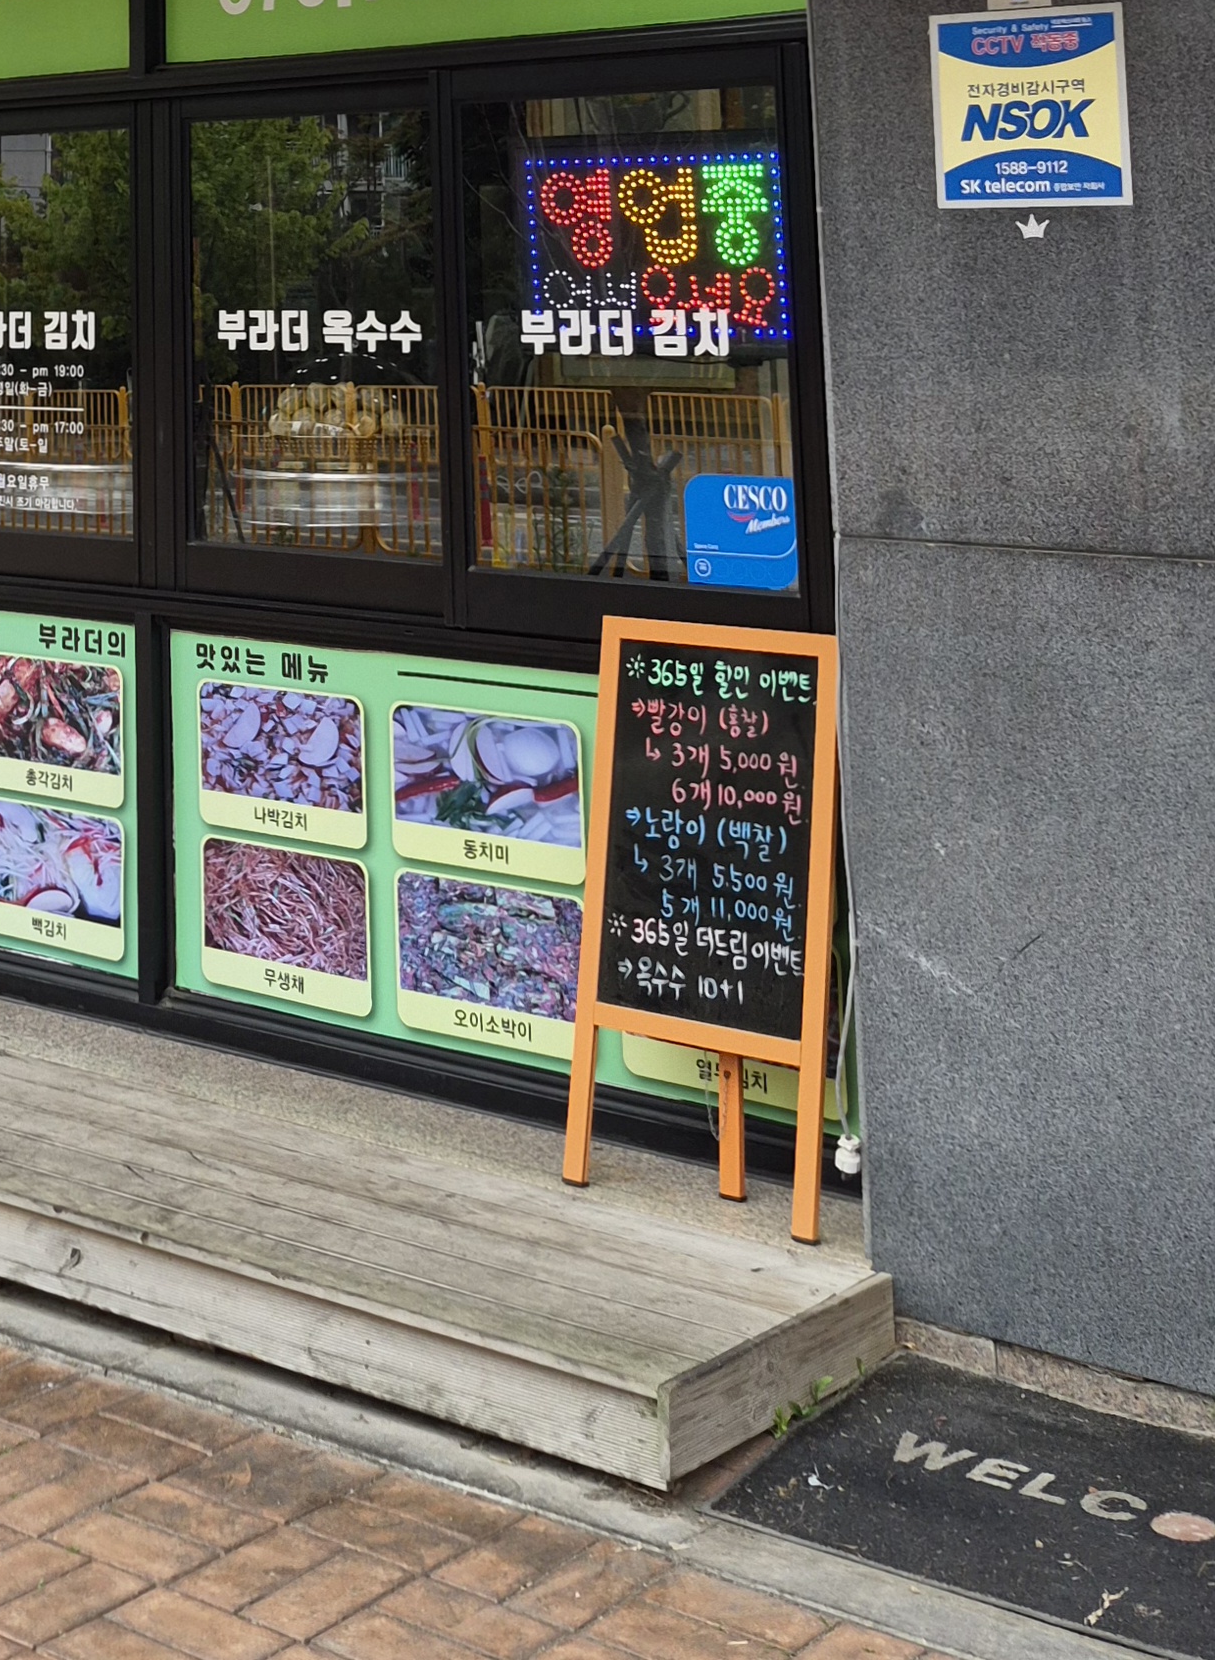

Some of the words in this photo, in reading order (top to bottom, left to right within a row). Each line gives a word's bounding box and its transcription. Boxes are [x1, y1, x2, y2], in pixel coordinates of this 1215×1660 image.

[971, 24, 1008, 35] Security
[1021, 23, 1049, 32] Safety
[971, 34, 1025, 56] CCTV
[1031, 31, 1080, 52] 작동중
[967, 78, 1085, 98] 전자경비감시구역
[961, 99, 1095, 142] NSOK
[995, 160, 1068, 175] 1588-9112
[960, 179, 981, 194] SK
[985, 178, 1051, 193] telecom
[540, 164, 769, 267] 영업중
[44, 310, 96, 350] 김치
[217, 309, 310, 352] 부라더
[322, 310, 423, 354] 옥수수
[520, 309, 634, 356] 부라더
[652, 309, 731, 357] 김치
[32, 366, 49, 379] pm
[53, 364, 85, 378] 19:00
[32, 422, 49, 435] pm
[53, 421, 85, 435] 17:00
[723, 483, 788, 512] CESCO
[745, 512, 791, 534] Members
[39, 623, 127, 657] 부라더의
[195, 643, 266, 676] 맛있는
[281, 652, 329, 683] 메뉴
[648, 659, 704, 695] 365일
[714, 660, 750, 700] 할인
[647, 698, 706, 737] 빨강이
[719, 704, 769, 739] (홍찰)
[671, 742, 709, 779] 3개
[25, 768, 73, 792] 총각김치
[672, 778, 711, 811] 6개
[253, 806, 308, 832] 나박김치
[645, 807, 705, 850] 노랑이
[717, 816, 788, 863] (백찰)
[462, 839, 510, 865] 동치미
[659, 854, 697, 891] 3개
[661, 888, 699, 927] 5개
[31, 916, 67, 941] 백김치
[631, 918, 689, 957] 365일
[696, 926, 748, 971] 더드림
[751, 940, 805, 977] 이벤트
[262, 968, 305, 995] 무생채
[637, 956, 686, 1001] 옥수수
[698, 975, 744, 1005] 10+1
[453, 1009, 533, 1042] 오이소박이
